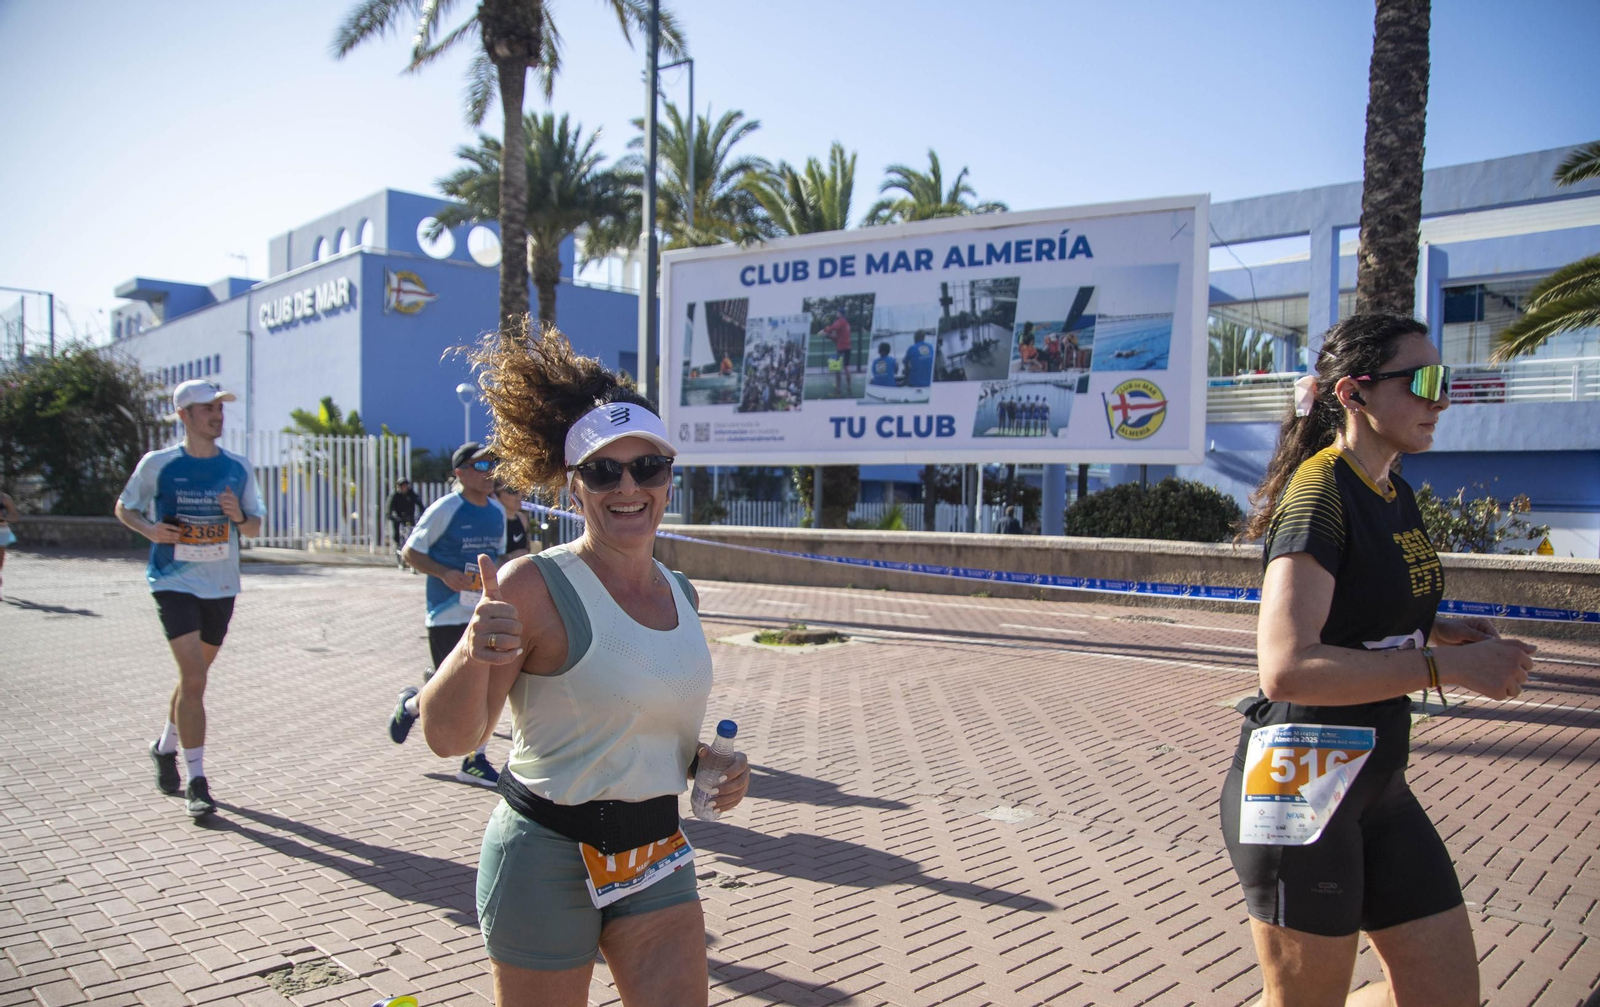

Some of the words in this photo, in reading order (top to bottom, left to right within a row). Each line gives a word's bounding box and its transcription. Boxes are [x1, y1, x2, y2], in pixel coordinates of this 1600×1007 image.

[739, 259, 810, 287] CLUB
[818, 254, 856, 279] DE
[865, 247, 934, 275] MAR
[942, 228, 1094, 269] ALMERÍA
[259, 295, 294, 329] CLUB
[294, 288, 315, 319] DE
[315, 275, 350, 312] MAR
[1116, 382, 1133, 395] CLUB
[829, 416, 866, 438] TU
[875, 415, 956, 438] CLUB
[182, 524, 225, 539] 2368
[1274, 735, 1300, 743] Almería
